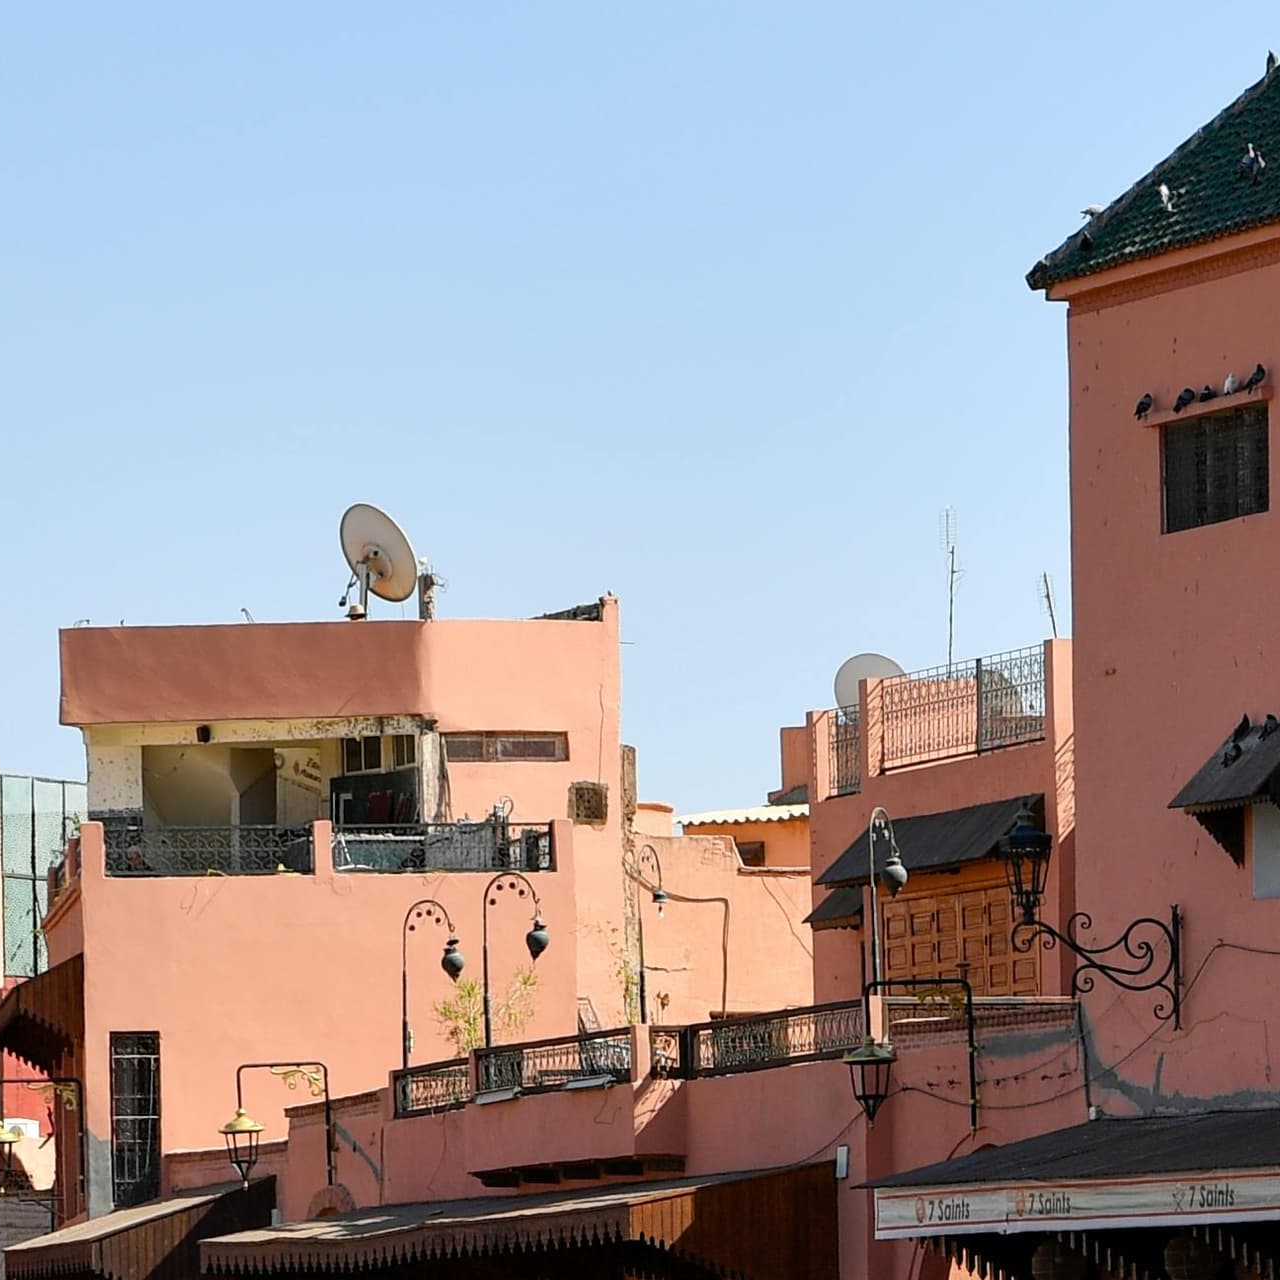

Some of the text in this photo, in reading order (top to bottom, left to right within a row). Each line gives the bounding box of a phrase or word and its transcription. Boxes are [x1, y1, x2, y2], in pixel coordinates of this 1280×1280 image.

[1028, 1191, 1071, 1215] 7 Saints
[1188, 1183, 1235, 1208] 7 Saints
[928, 1198, 970, 1222] 7 Saints
